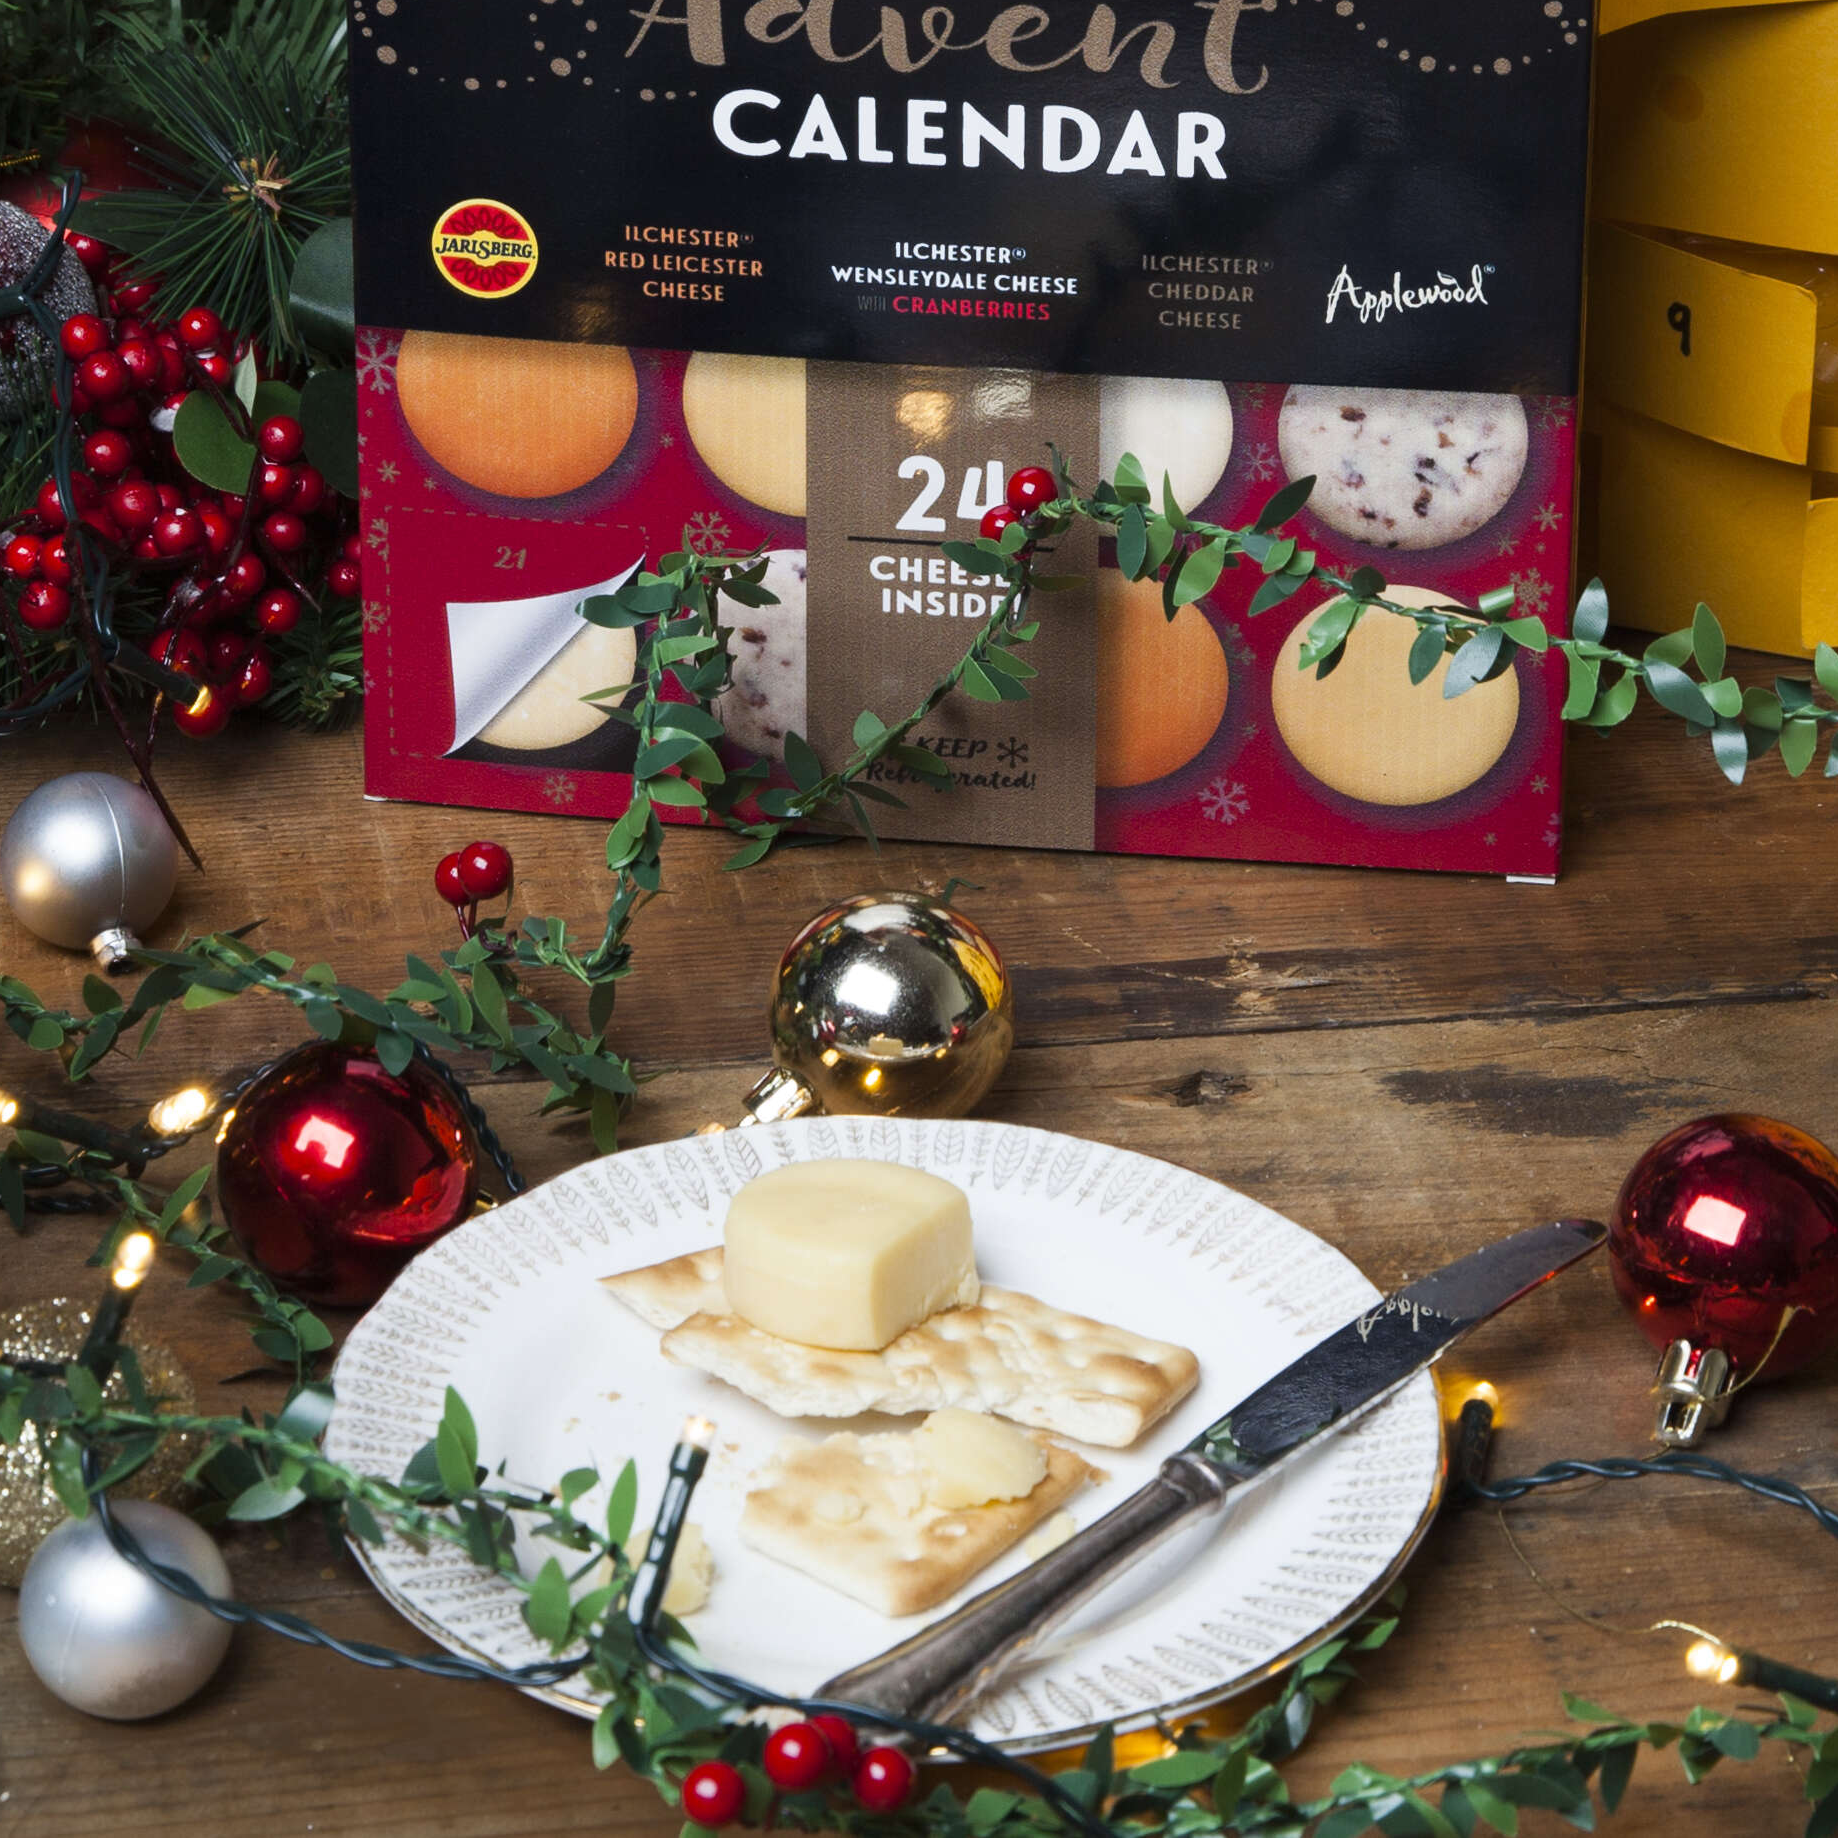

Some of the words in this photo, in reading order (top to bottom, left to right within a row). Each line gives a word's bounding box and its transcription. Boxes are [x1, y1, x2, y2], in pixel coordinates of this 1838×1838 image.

[712, 88, 1228, 180] CALENDAR
[605, 250, 645, 269] RED
[653, 254, 763, 277] LEICESTER
[643, 281, 725, 302] CHEESE
[831, 265, 987, 291] WENSLEYDALE
[994, 274, 1079, 296] CHEESE
[1148, 282, 1255, 303] CHEDDAR
[1325, 263, 1489, 324] Applewood
[892, 295, 1051, 321] CRANBERRIES
[1158, 310, 1243, 330] CHEESE
[1666, 299, 1694, 358] 9
[895, 454, 1005, 533] 24
[493, 546, 527, 571] 21
